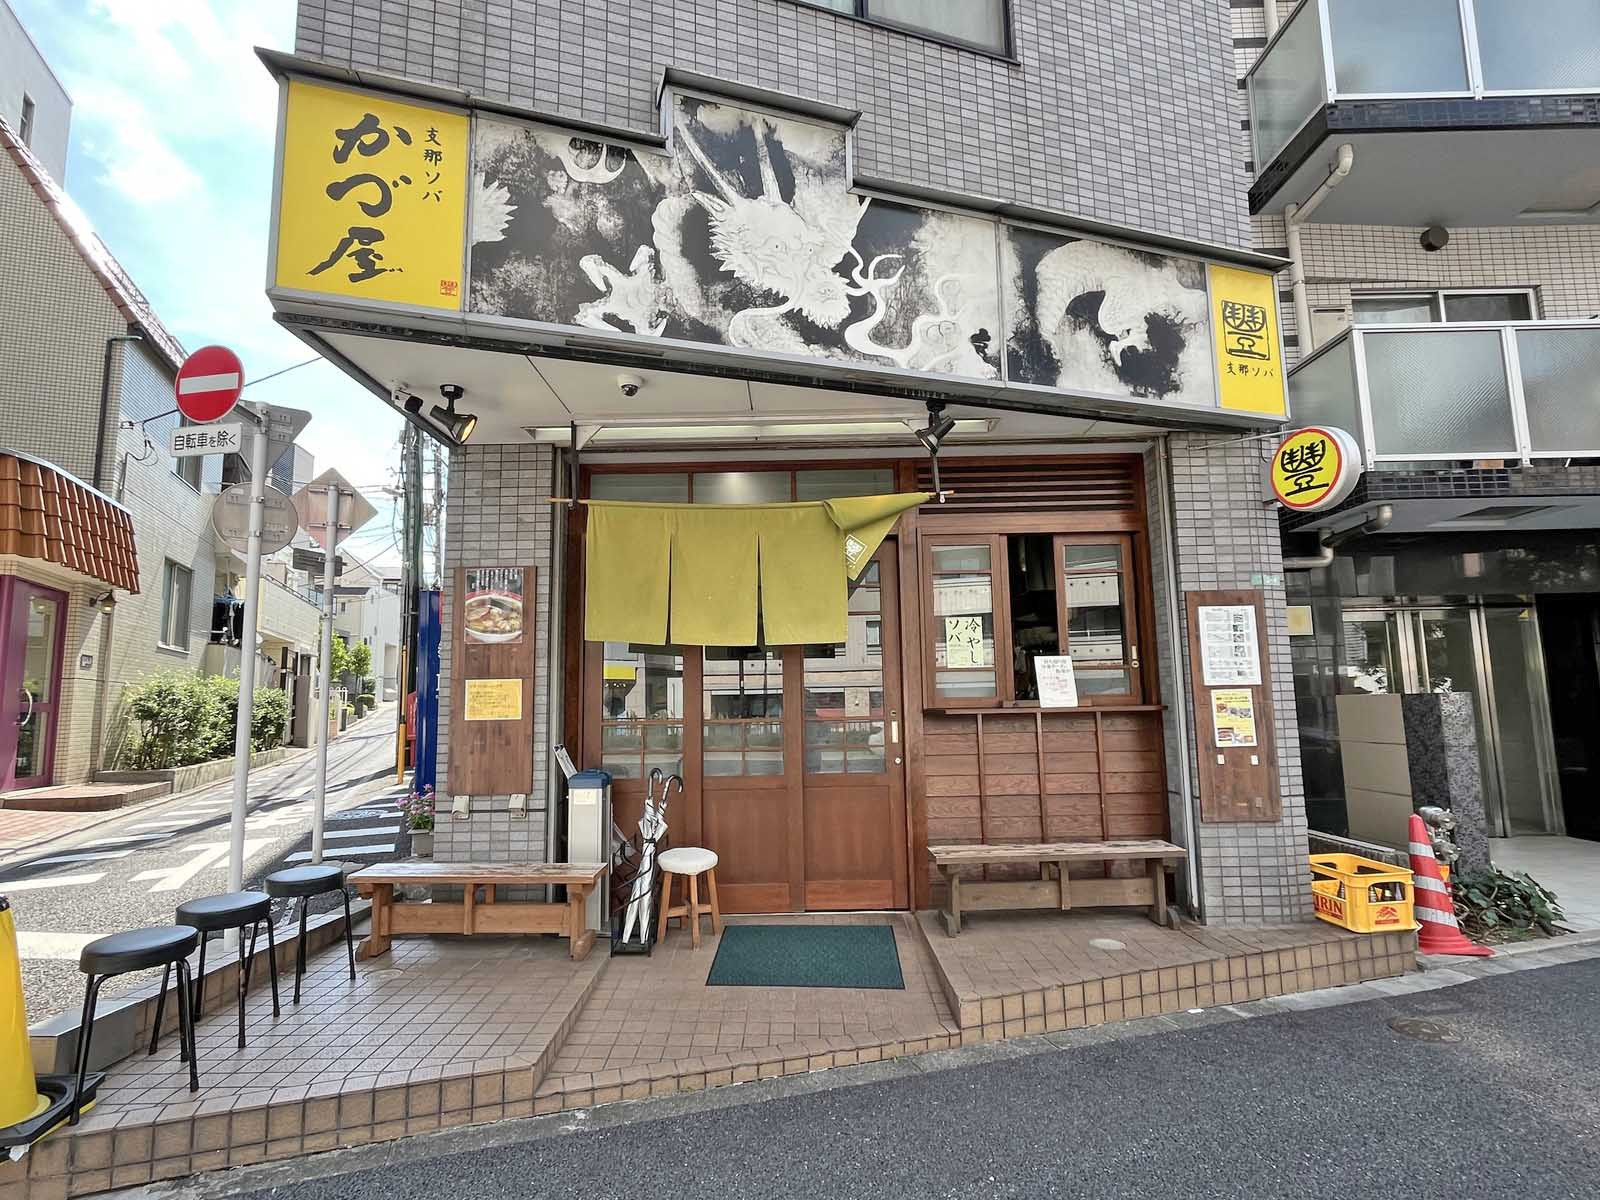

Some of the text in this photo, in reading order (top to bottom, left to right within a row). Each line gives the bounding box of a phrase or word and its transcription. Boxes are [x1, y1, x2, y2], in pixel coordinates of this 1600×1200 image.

[422, 127, 443, 202] 支那ソバ
[305, 112, 413, 283] かづ屋
[1226, 361, 1274, 377] 支那ソバ
[174, 430, 237, 451] 自転車を除く
[948, 619, 962, 643] ソバ
[965, 618, 981, 664] 冷やし
